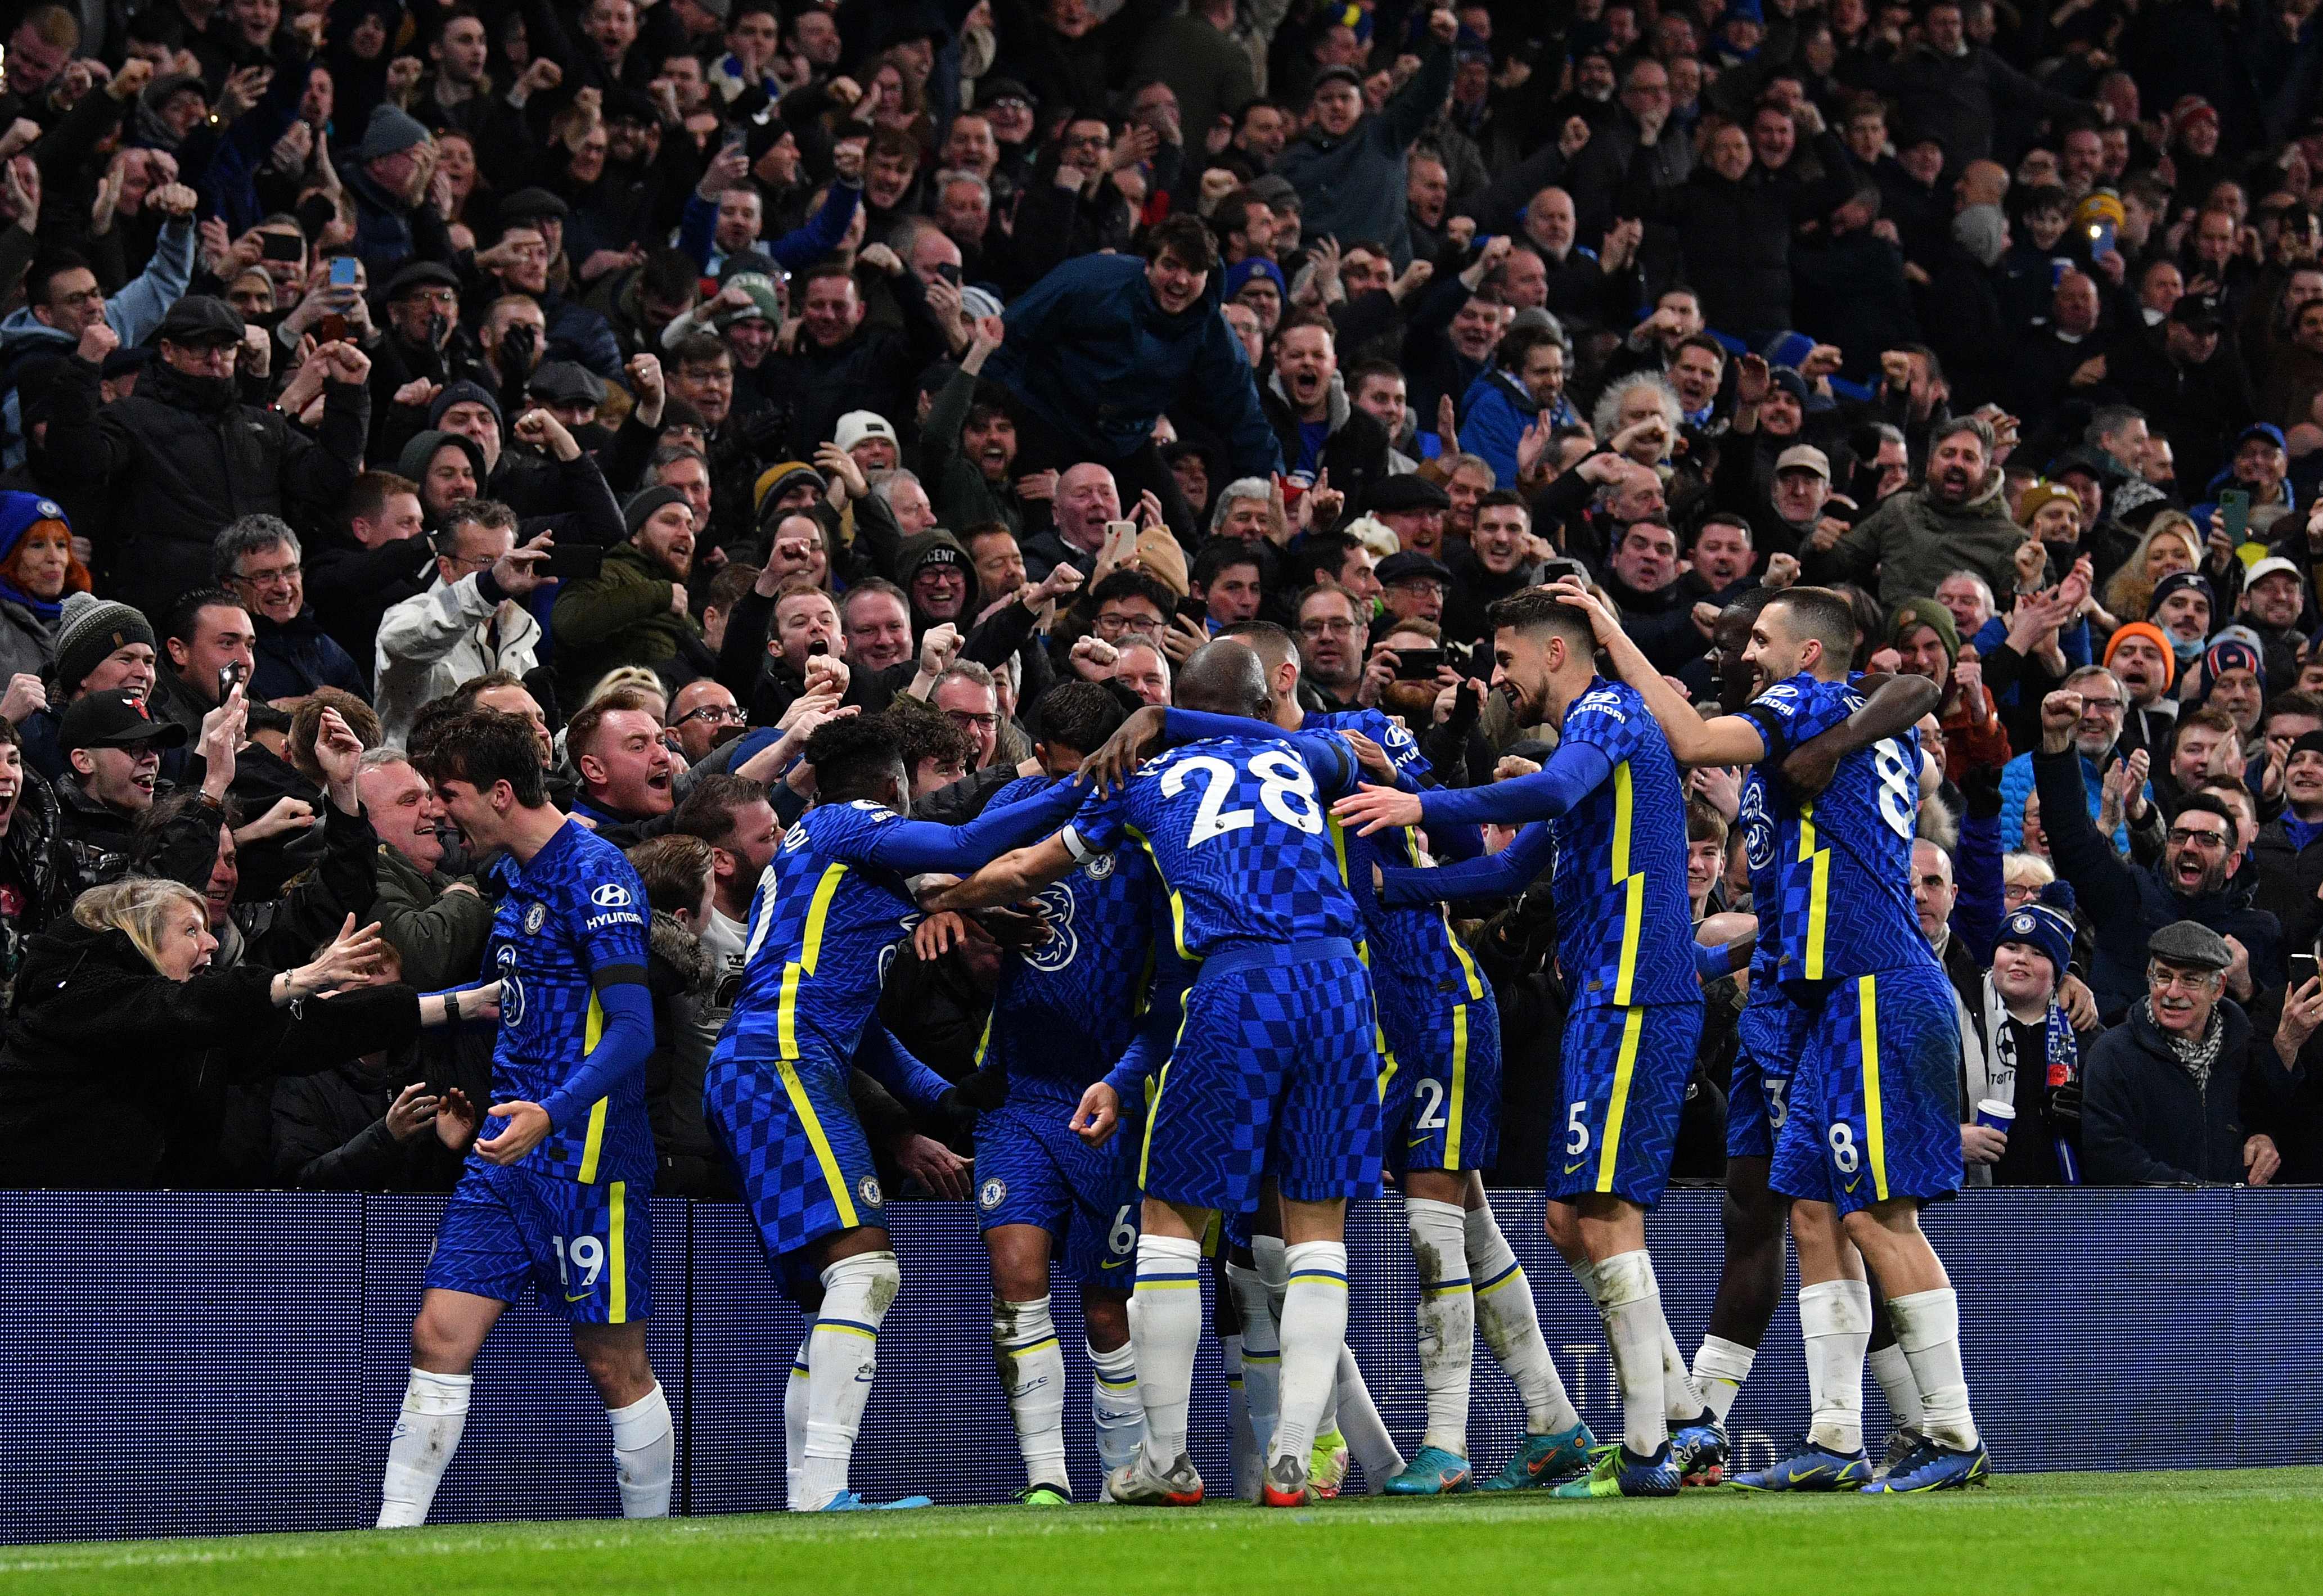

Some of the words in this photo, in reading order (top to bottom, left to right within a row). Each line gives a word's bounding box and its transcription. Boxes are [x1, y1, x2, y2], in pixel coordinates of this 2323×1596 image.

[1160, 750, 1323, 849] 28
[1875, 738, 1915, 839] 8
[1566, 1101, 1590, 1155] 5
[1765, 1079, 1788, 1128] 3
[1829, 1122, 1858, 1173] 8
[1108, 1204, 1136, 1255] 6
[552, 1235, 604, 1286] 19
